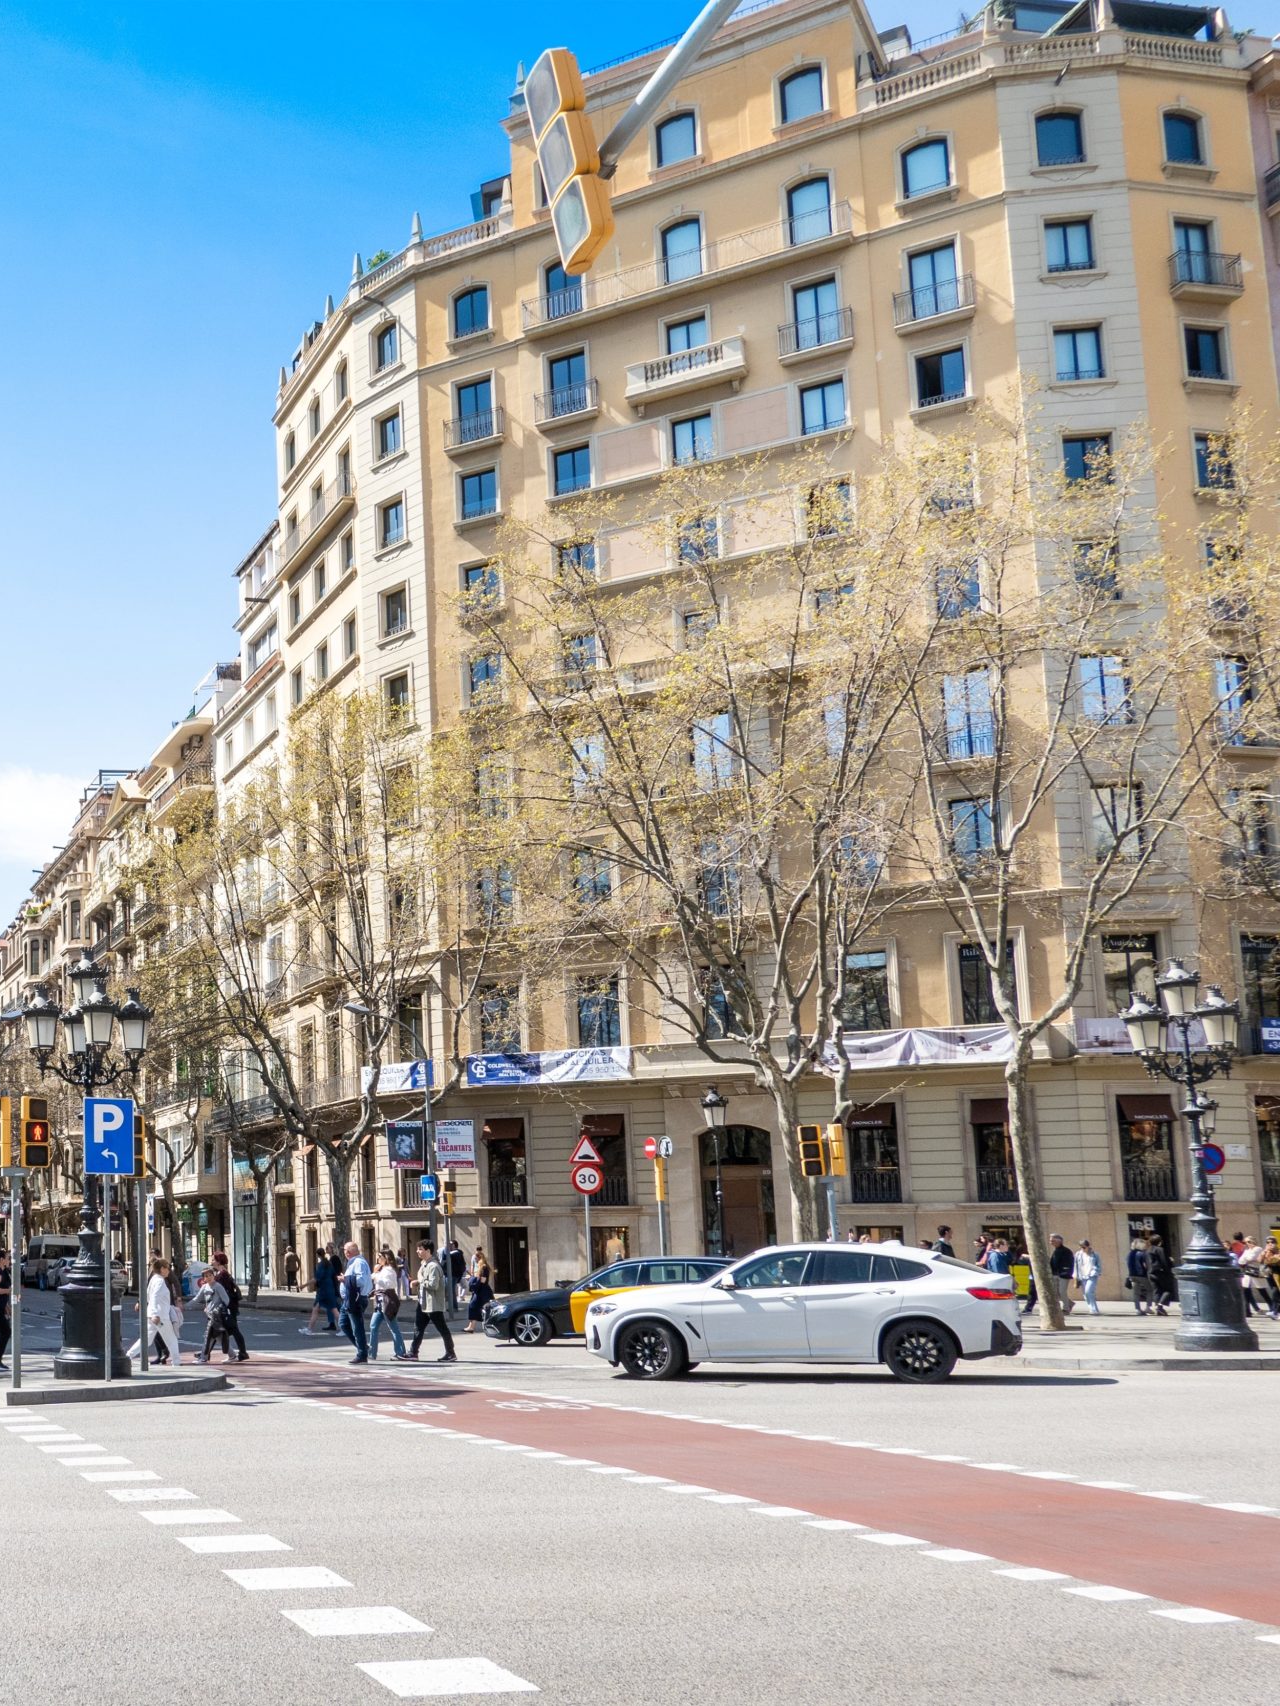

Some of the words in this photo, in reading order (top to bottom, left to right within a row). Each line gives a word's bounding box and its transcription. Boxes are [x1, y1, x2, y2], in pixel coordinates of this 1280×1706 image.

[93, 1103, 125, 1143] P
[437, 1137, 449, 1145] ELS
[438, 1144, 472, 1152] ENCANTATS
[578, 1173, 597, 1184] 30
